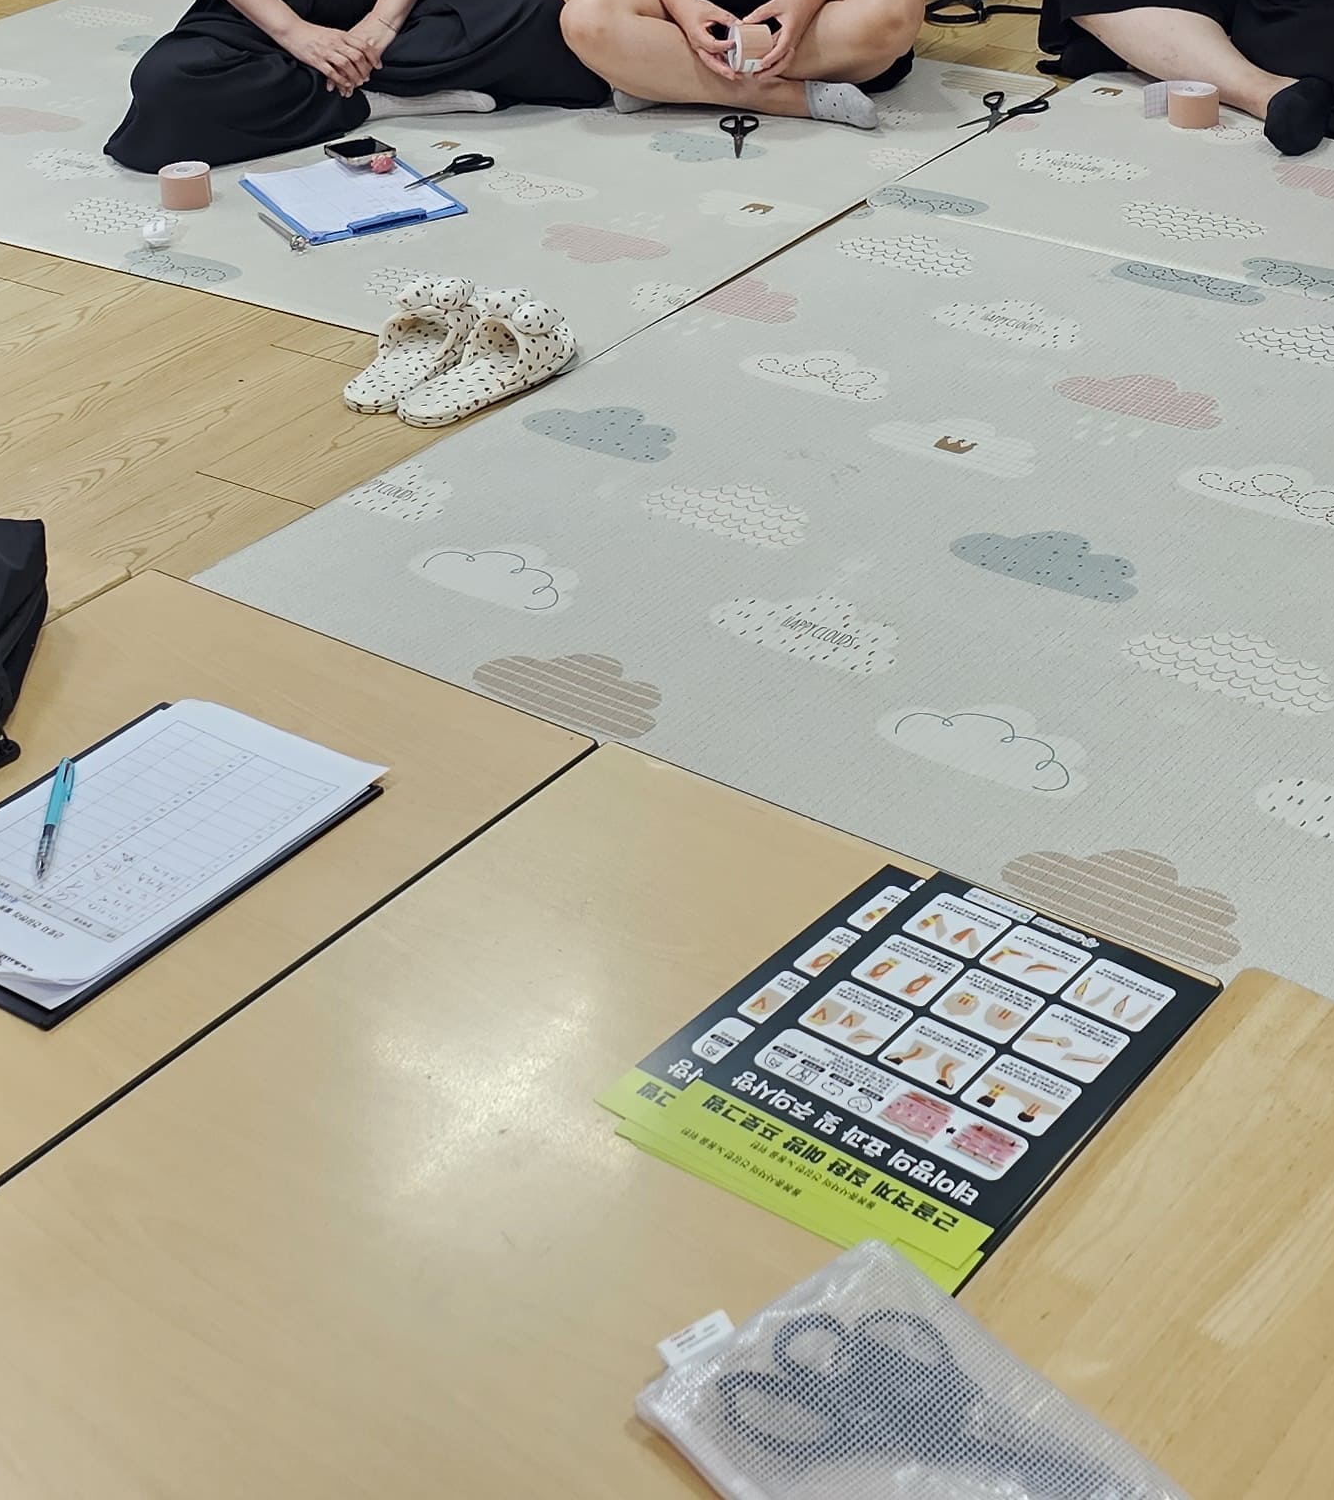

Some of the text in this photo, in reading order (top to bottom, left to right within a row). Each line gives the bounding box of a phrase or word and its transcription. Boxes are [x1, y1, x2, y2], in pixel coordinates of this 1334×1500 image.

[780, 616, 859, 648] HAPPY CLOUDS
[731, 1070, 815, 1122] 주의사항
[813, 1110, 844, 1135] 및
[840, 1126, 891, 1159] 효과
[702, 1094, 960, 1232] 근골격계 질환 예방 프로그램
[887, 1148, 979, 1206] 테이핑의
